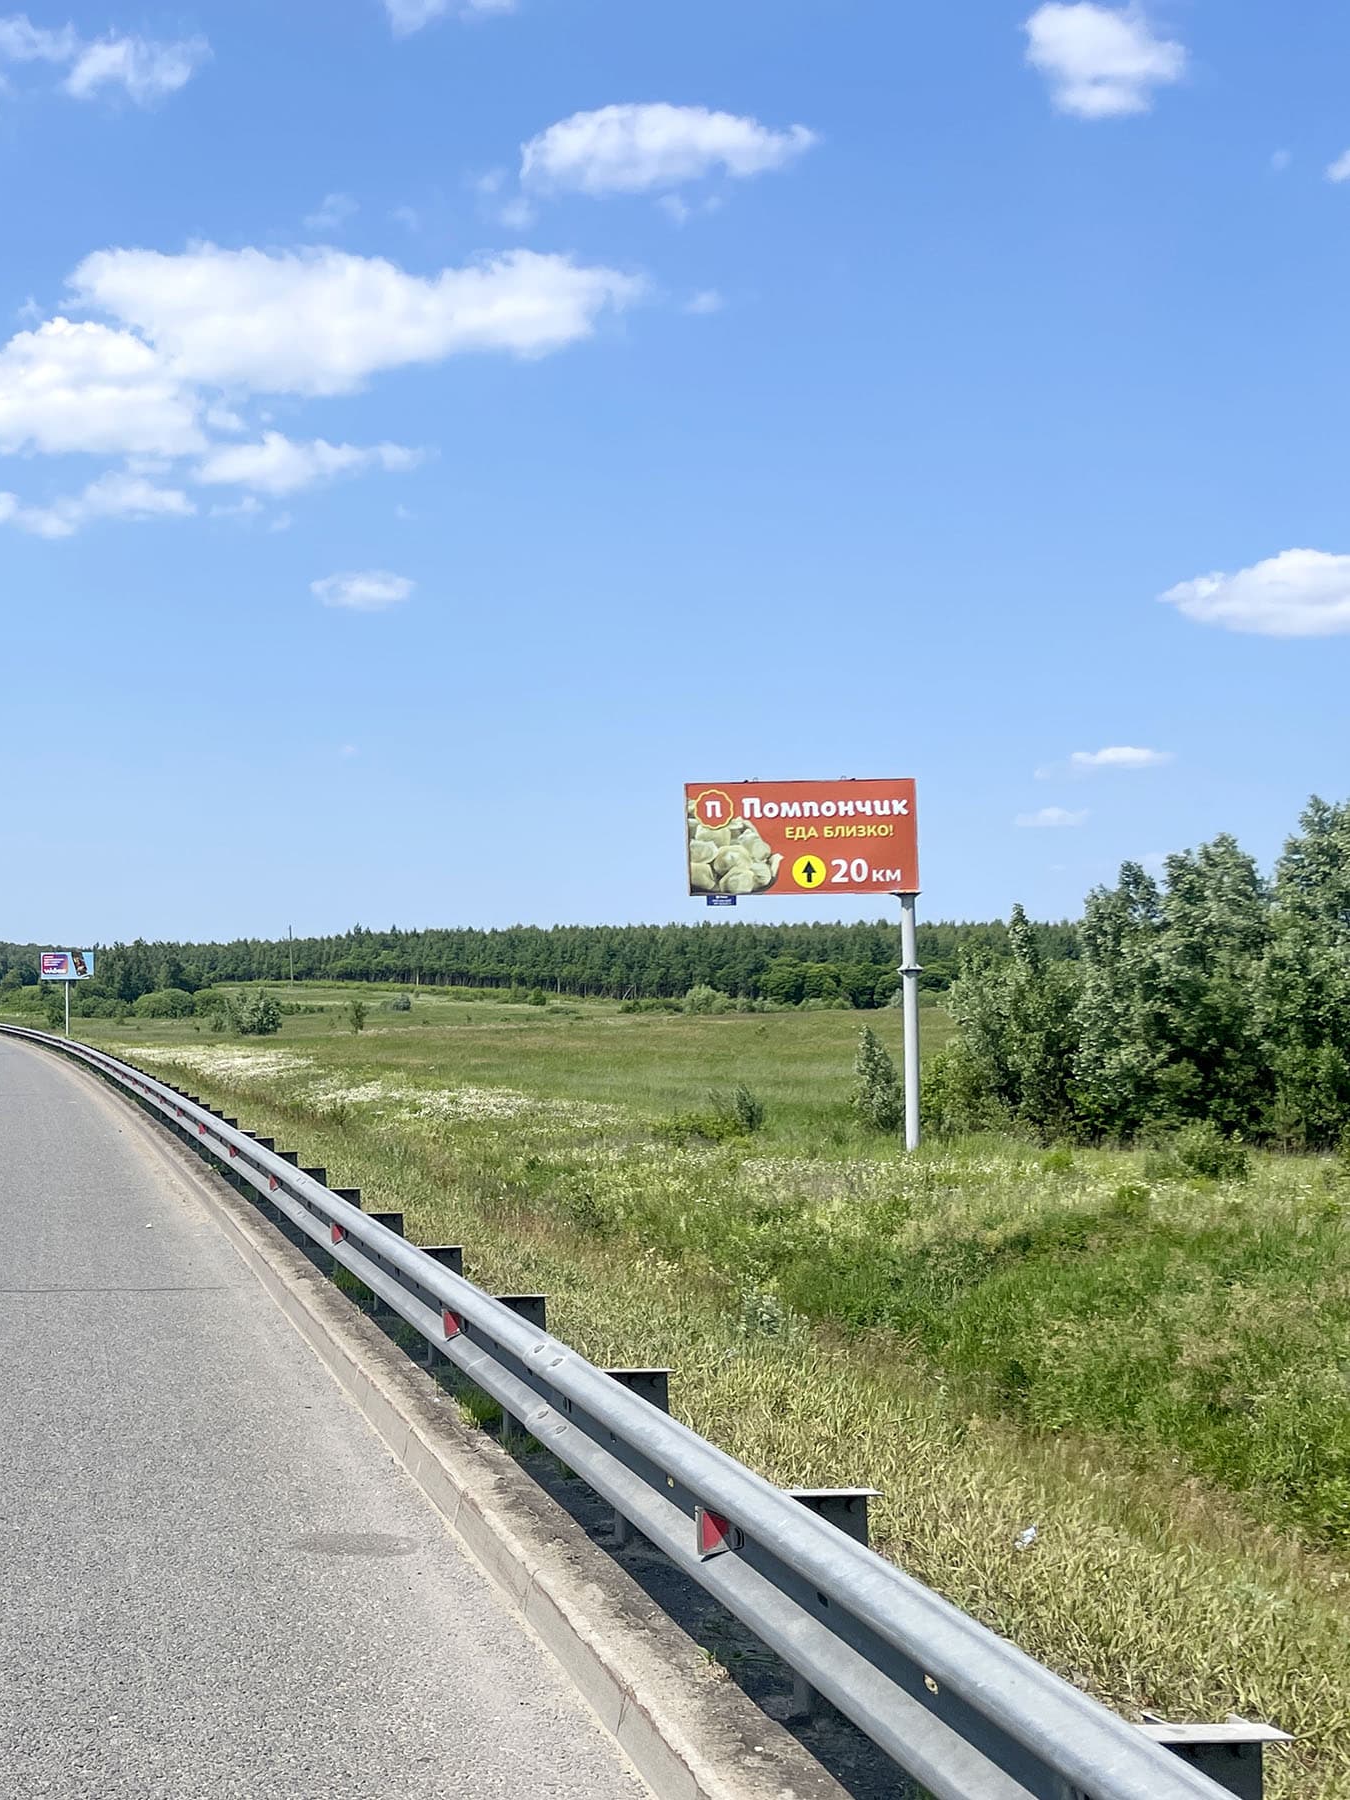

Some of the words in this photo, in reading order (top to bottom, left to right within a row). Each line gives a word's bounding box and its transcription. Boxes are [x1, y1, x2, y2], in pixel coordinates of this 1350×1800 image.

[741, 797, 909, 819] Помпончик
[785, 826, 819, 841] ЕДА
[823, 824, 894, 838] БЛИЗКО!
[831, 858, 869, 883] 20
